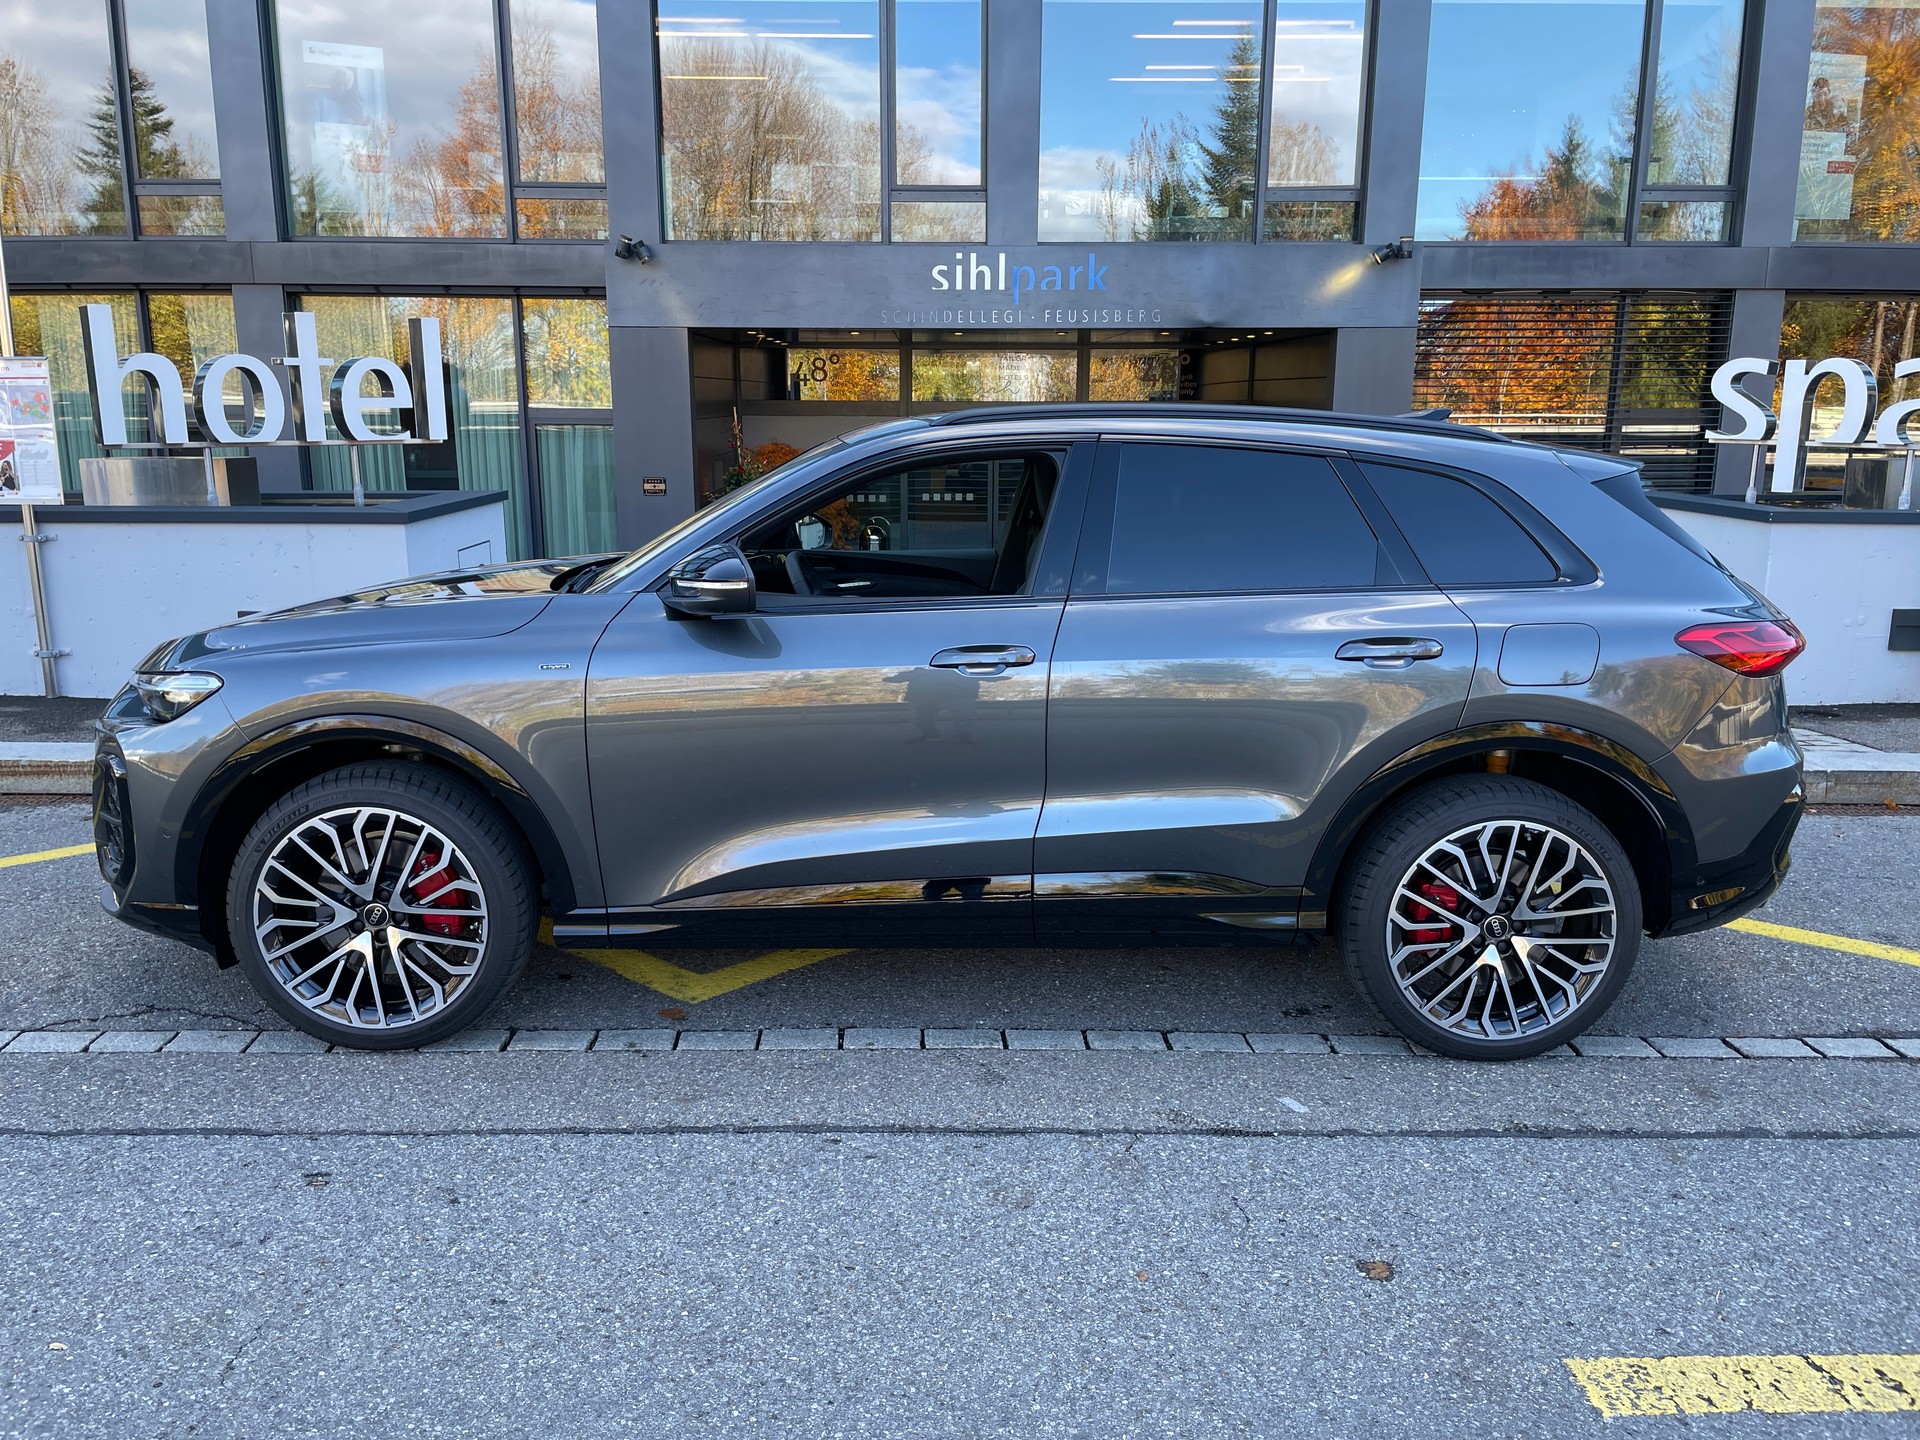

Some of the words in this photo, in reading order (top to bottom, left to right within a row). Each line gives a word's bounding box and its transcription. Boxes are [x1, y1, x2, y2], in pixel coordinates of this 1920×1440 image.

[931, 252, 1109, 305] sihlpark
[880, 309, 1023, 325] SCHINDELLEGI
[1044, 309, 1162, 324] FEUSISBERG
[80, 304, 448, 445] hotel
[263, 805, 308, 841] MICHELIN
